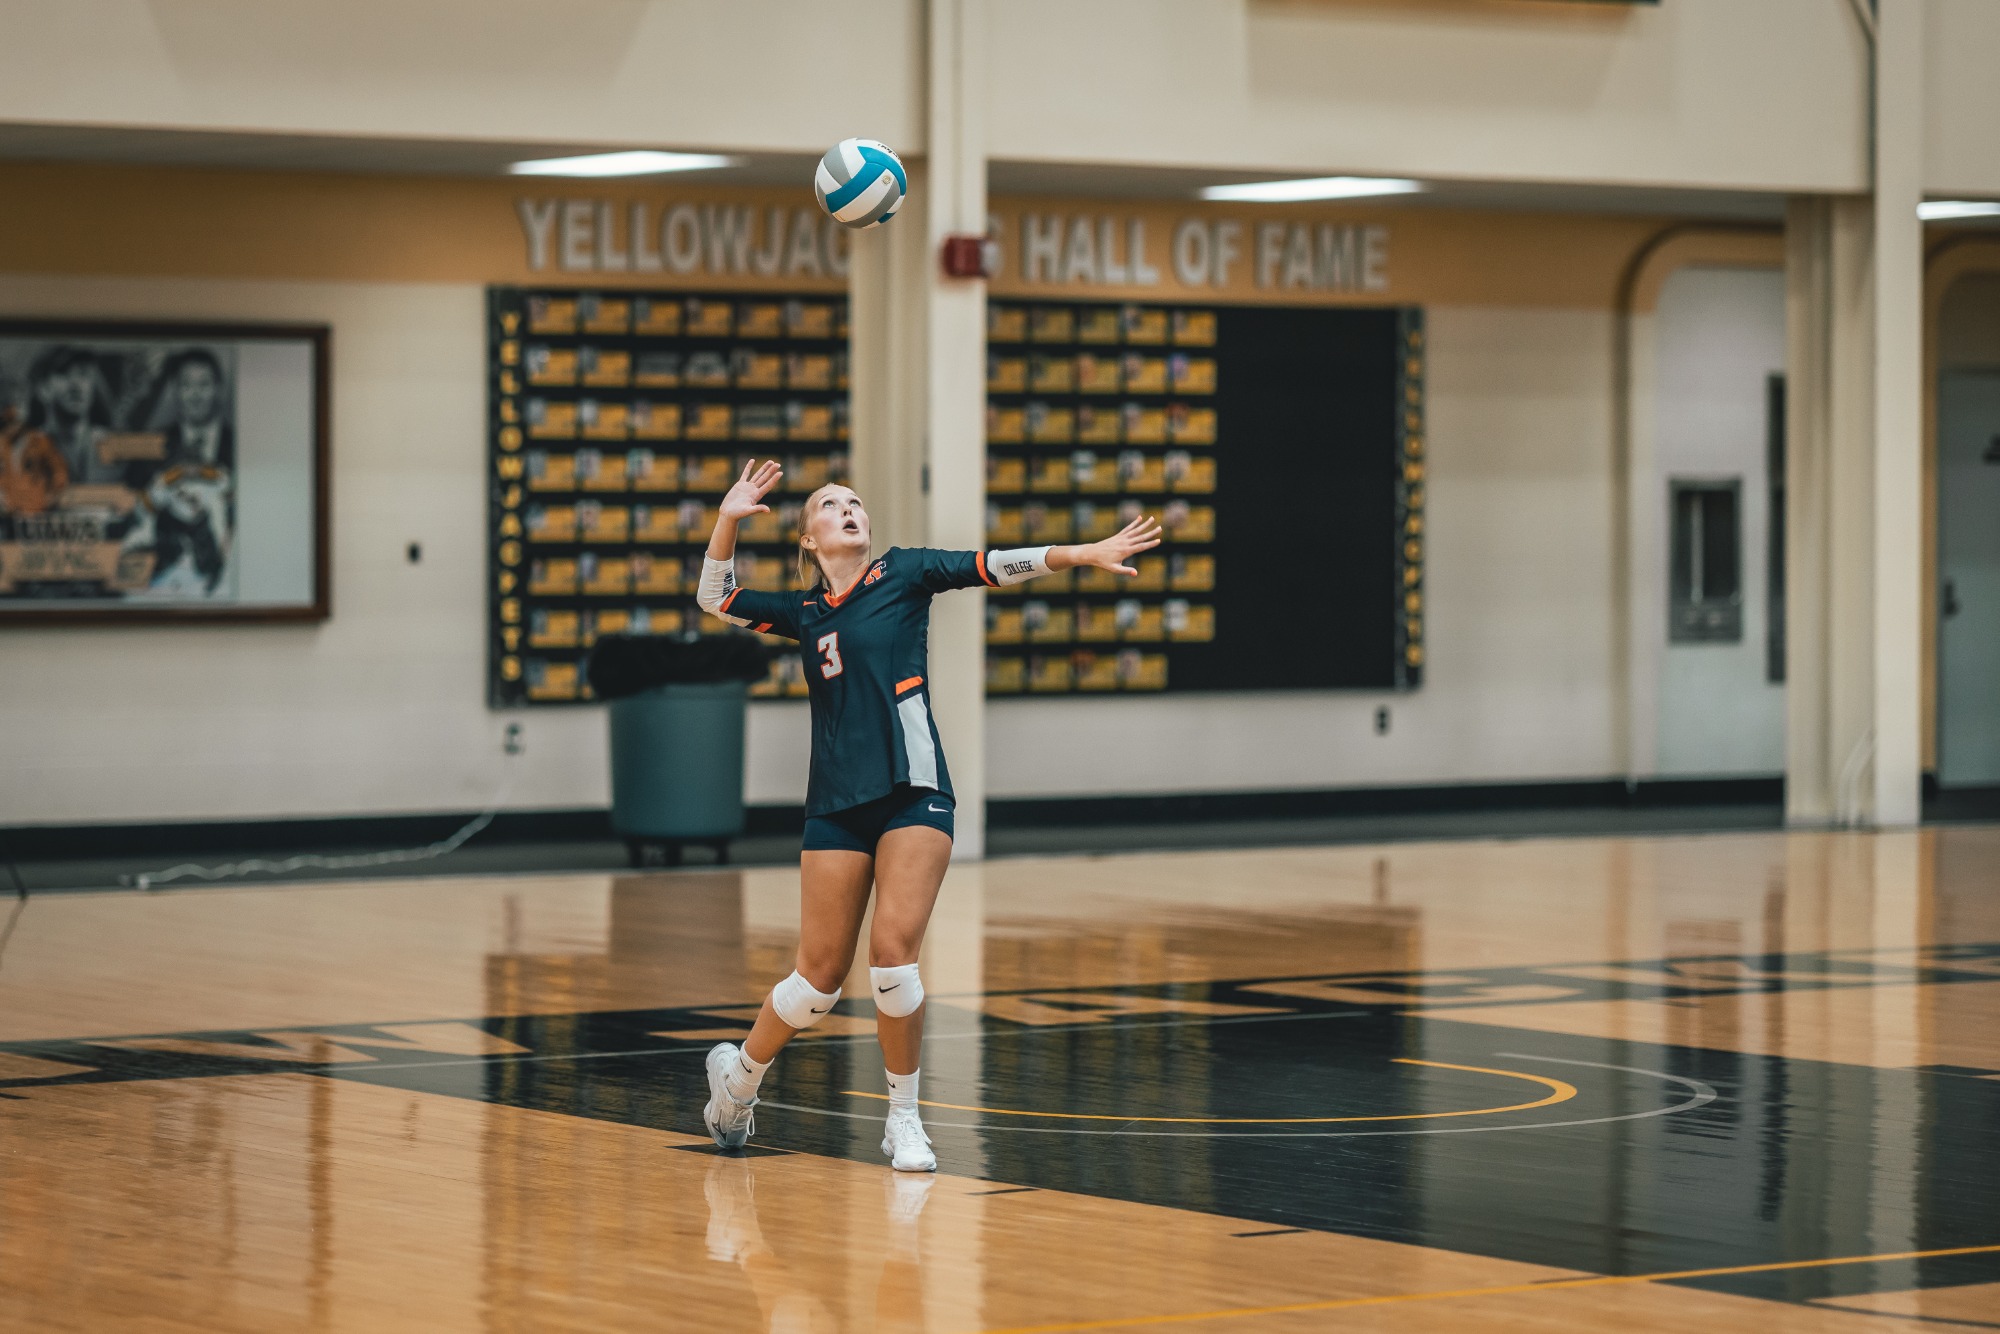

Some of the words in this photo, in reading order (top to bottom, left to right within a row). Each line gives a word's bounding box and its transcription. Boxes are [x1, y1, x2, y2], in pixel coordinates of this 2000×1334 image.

[516, 199, 1004, 278] YELLOWJAC
[1021, 212, 1158, 285] HALL
[1171, 215, 1244, 287] OF
[1254, 220, 1391, 292] FAME
[1003, 560, 1035, 576] COLLEGE
[817, 631, 844, 680] 3
